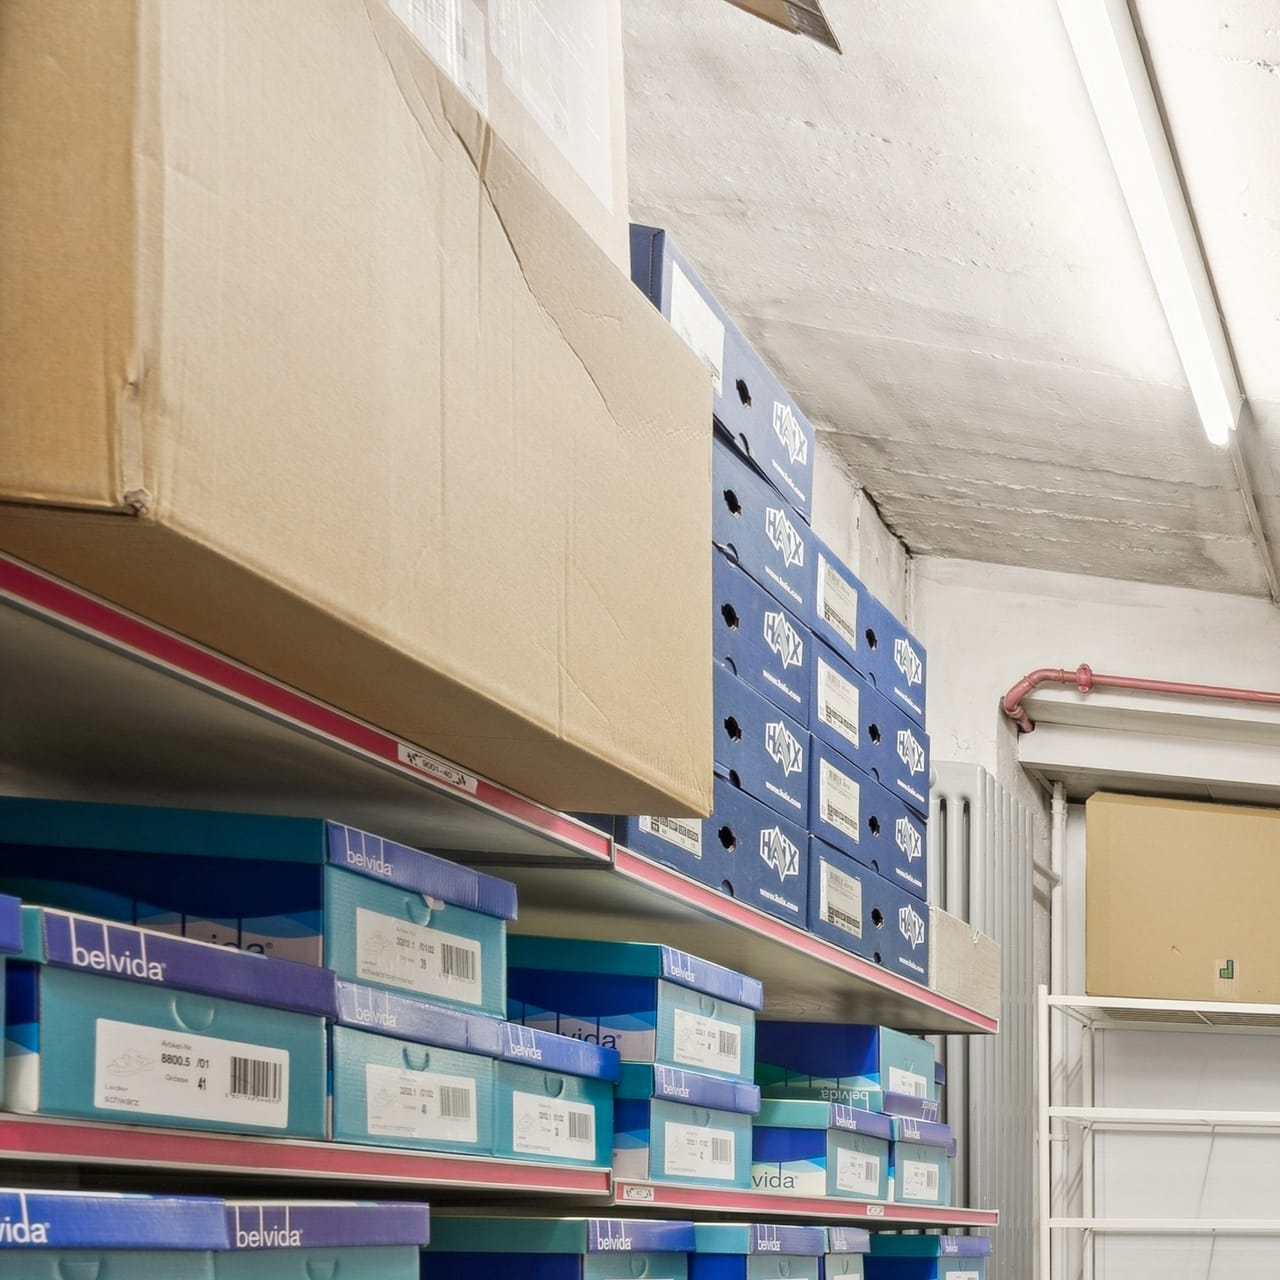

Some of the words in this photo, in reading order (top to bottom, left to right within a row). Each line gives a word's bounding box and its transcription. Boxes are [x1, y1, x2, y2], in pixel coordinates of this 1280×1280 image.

[345, 826, 393, 876] belvida
[70, 917, 164, 981] belvida
[669, 948, 695, 982] belvida
[354, 984, 397, 1026] belvida
[508, 1024, 542, 1060] belvida
[161, 1053, 191, 1067] 8800.5
[662, 1066, 690, 1098] belvida
[752, 1162, 796, 1189] vida
[236, 1205, 302, 1247] belvida
[597, 1220, 632, 1250] belvida
[757, 1224, 781, 1251] belvida
